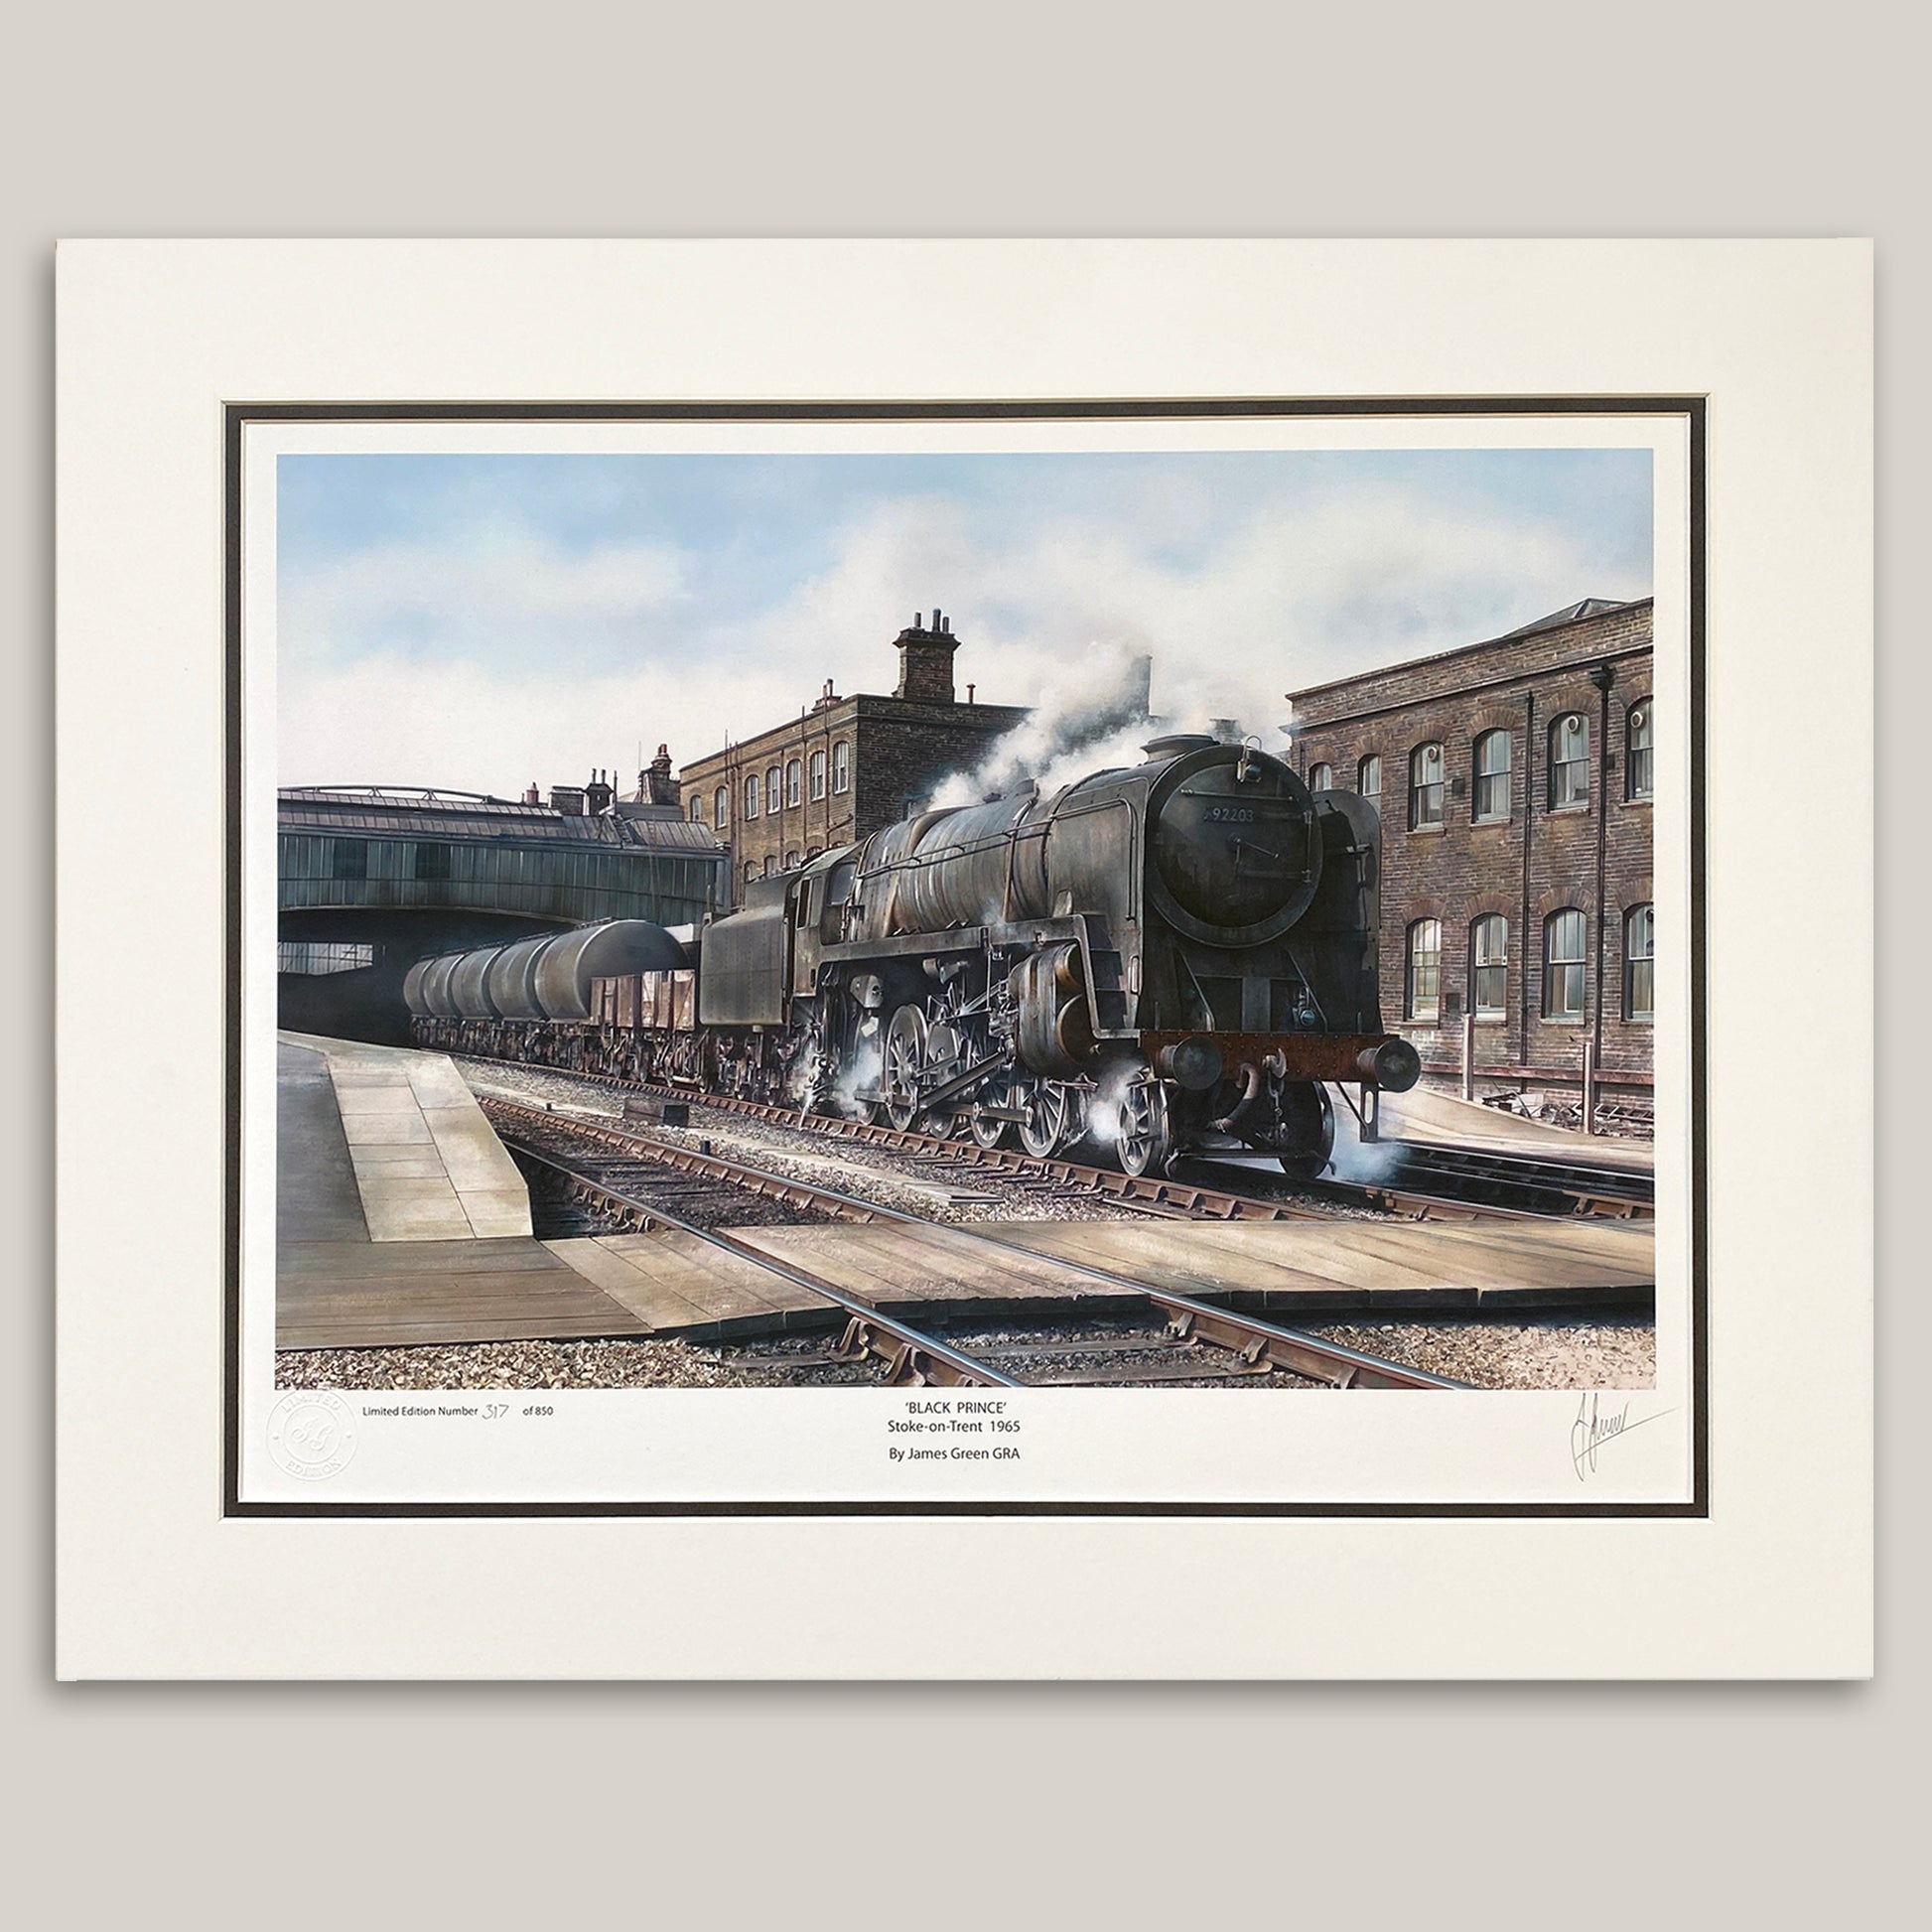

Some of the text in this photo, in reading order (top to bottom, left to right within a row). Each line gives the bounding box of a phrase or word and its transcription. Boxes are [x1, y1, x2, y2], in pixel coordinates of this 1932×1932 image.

[1212, 807, 1255, 822] 92203
[362, 1404, 554, 1420] Limited Edition Number 317 of 850
[904, 1401, 1008, 1415] 'BLACK PRINCE'
[887, 1419, 1021, 1434] Stoke-on-Trent 1965
[889, 1447, 1021, 1463] By James Green GRA
